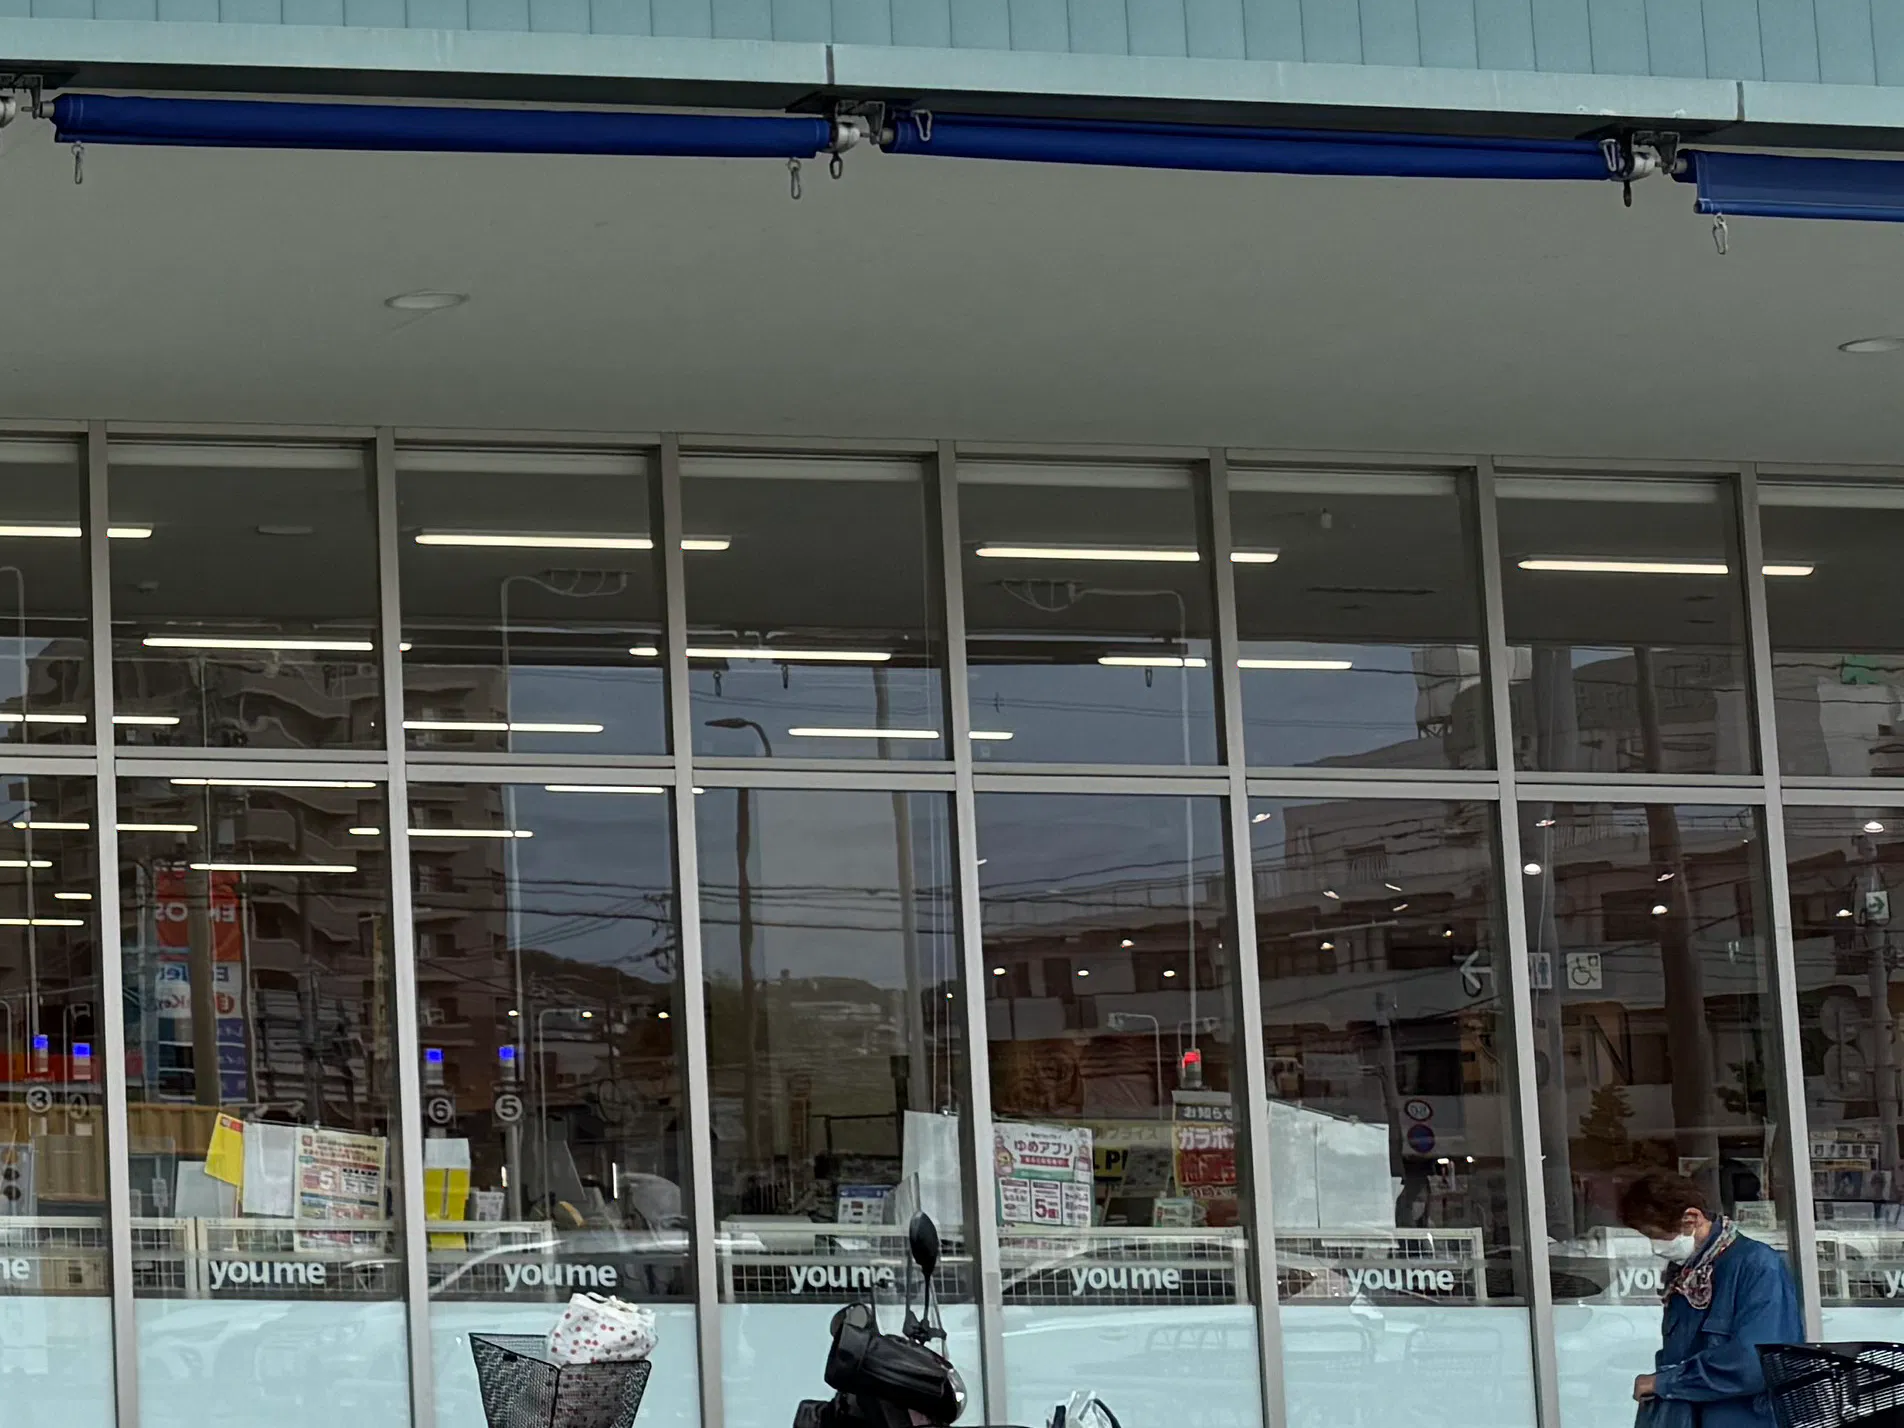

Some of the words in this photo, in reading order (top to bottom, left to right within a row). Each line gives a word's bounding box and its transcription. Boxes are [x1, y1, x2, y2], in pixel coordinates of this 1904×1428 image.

[1014, 1140, 1073, 1156] ゆめアプリ
[210, 1259, 326, 1289] youme
[503, 1261, 617, 1292] youme
[1071, 1265, 1180, 1296] youme
[1347, 1266, 1455, 1296] youme
